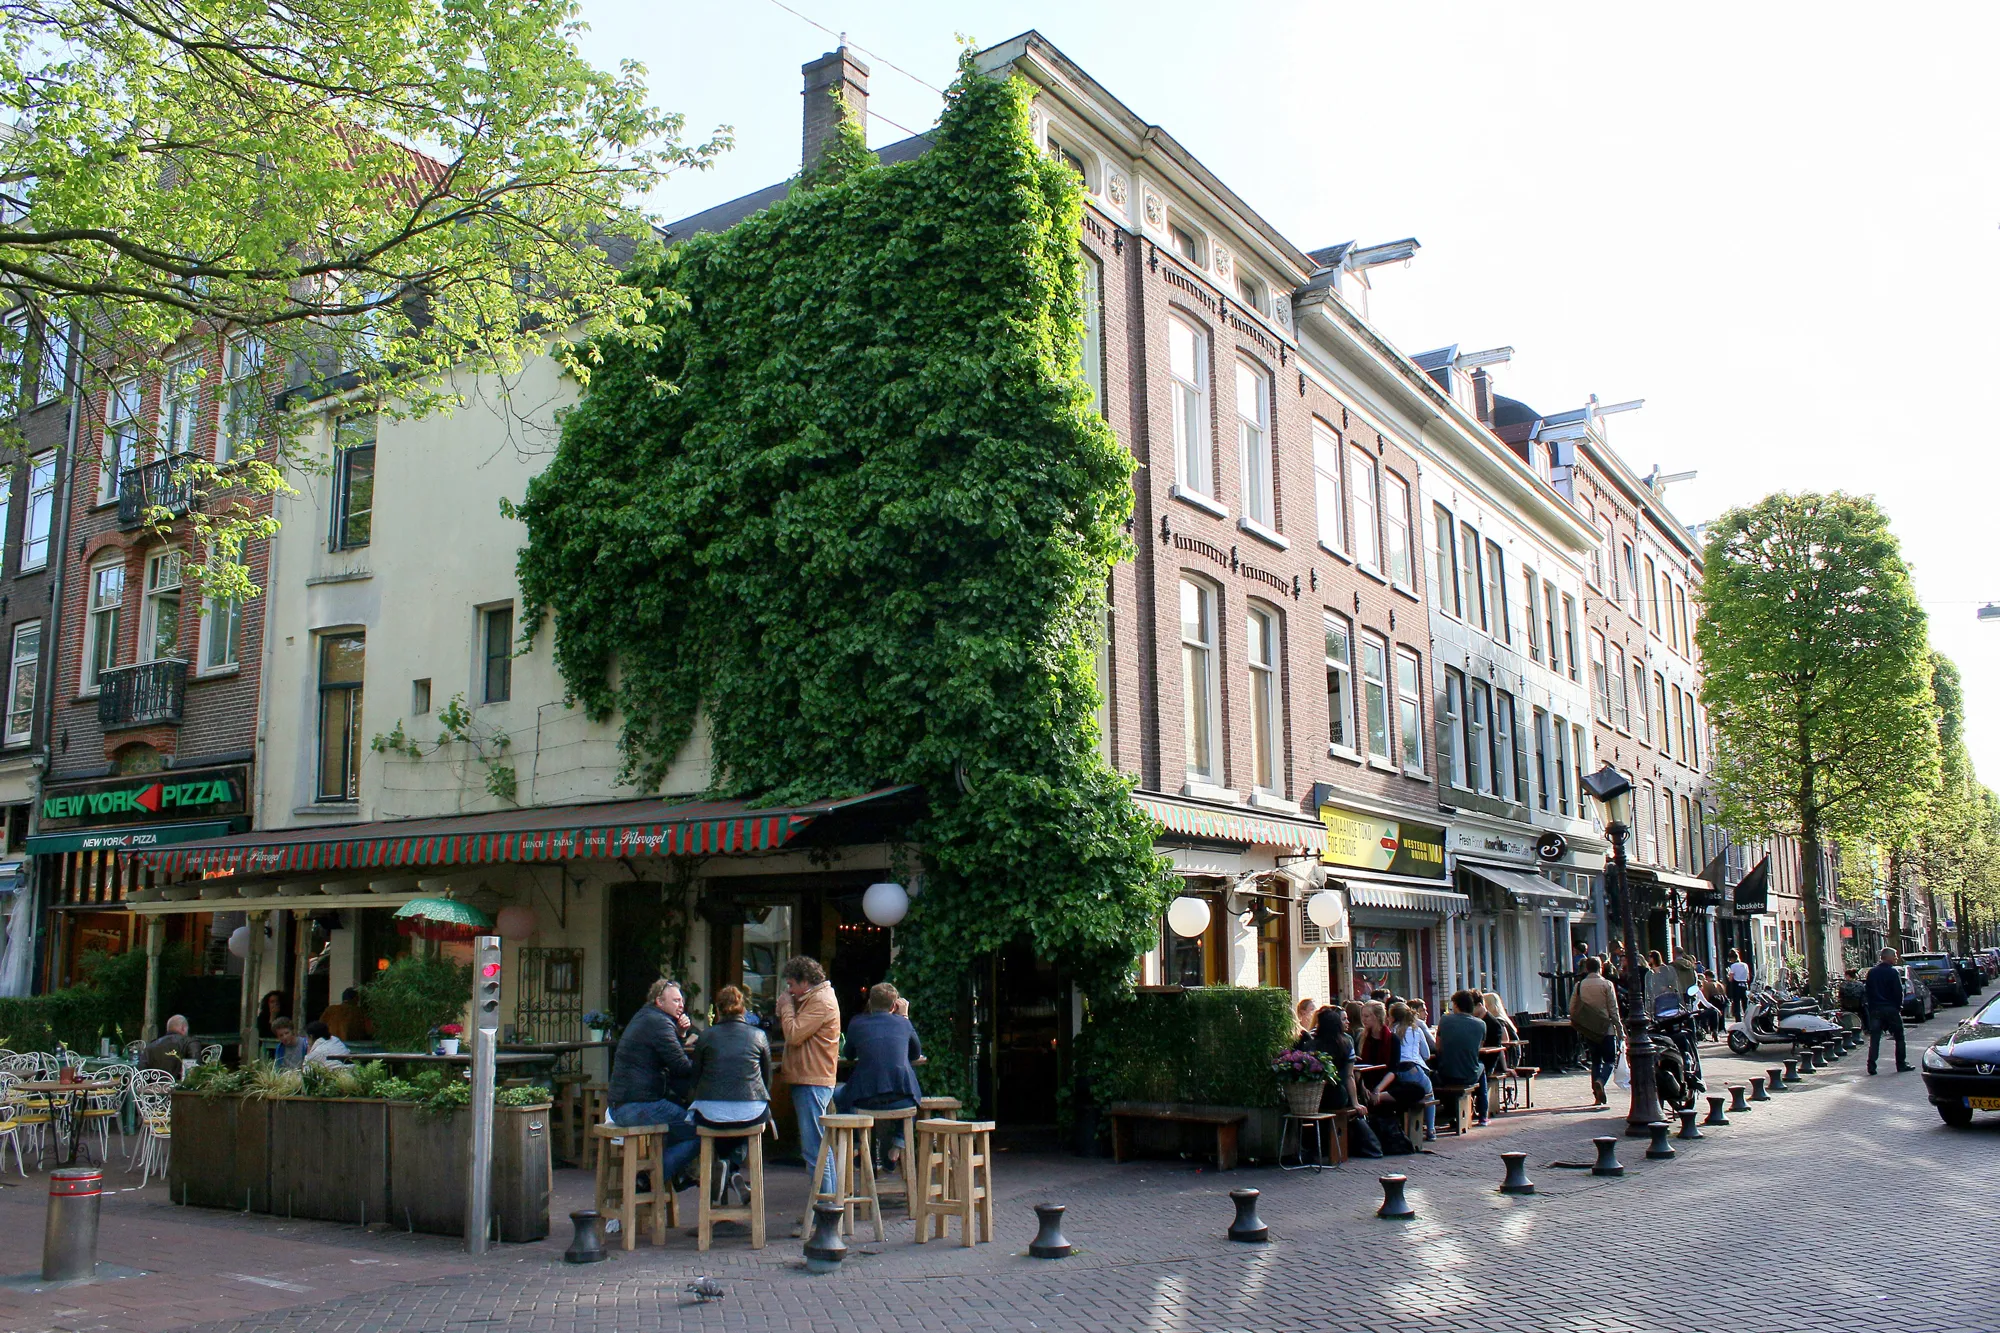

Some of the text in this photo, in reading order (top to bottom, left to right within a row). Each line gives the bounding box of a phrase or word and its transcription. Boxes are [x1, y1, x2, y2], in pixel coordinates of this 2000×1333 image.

[43, 780, 231, 818] NEW YORK PIZZA
[83, 834, 157, 847] NEW YORK PIZZA
[522, 841, 544, 849] LUNCH
[553, 838, 573, 847] TAPAS
[585, 837, 606, 845] DINER
[1403, 838, 1427, 851] WESTERN
[1459, 833, 1471, 846] Fresh
[1472, 836, 1483, 848] Food
[1411, 849, 1428, 861] UNION
